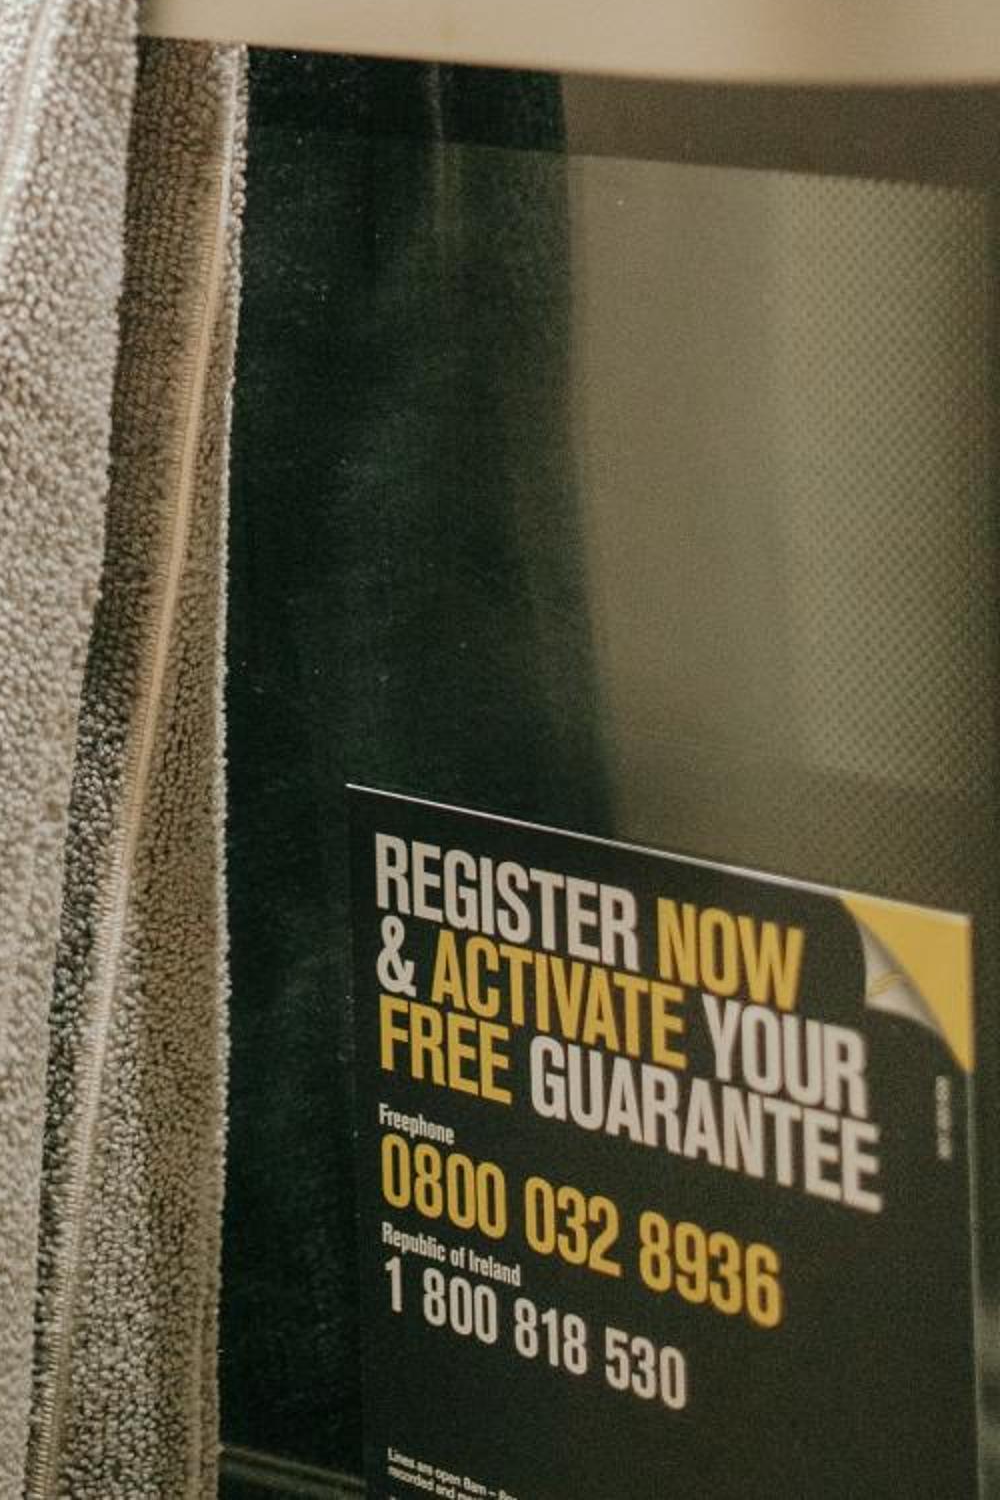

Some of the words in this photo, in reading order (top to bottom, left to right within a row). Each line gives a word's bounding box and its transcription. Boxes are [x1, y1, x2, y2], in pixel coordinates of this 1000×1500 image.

[375, 833, 639, 972] REGISTER
[657, 897, 803, 1010] NOW
[377, 915, 416, 997] &
[431, 929, 687, 1069] ACTIVATE
[702, 994, 868, 1117] YOUR
[379, 994, 512, 1104] FREE
[530, 1035, 882, 1213] GUARANTEE
[378, 1103, 455, 1145] Freephone
[382, 1133, 507, 1239] 0800
[525, 1176, 621, 1277] 032
[638, 1211, 784, 1329] 8936
[382, 1221, 446, 1262] Republic
[451, 1247, 465, 1268] of
[469, 1250, 521, 1287] Ireland
[385, 1256, 402, 1313] 1
[423, 1268, 498, 1344] 800
[515, 1297, 587, 1375] 818
[605, 1327, 686, 1410] 530
